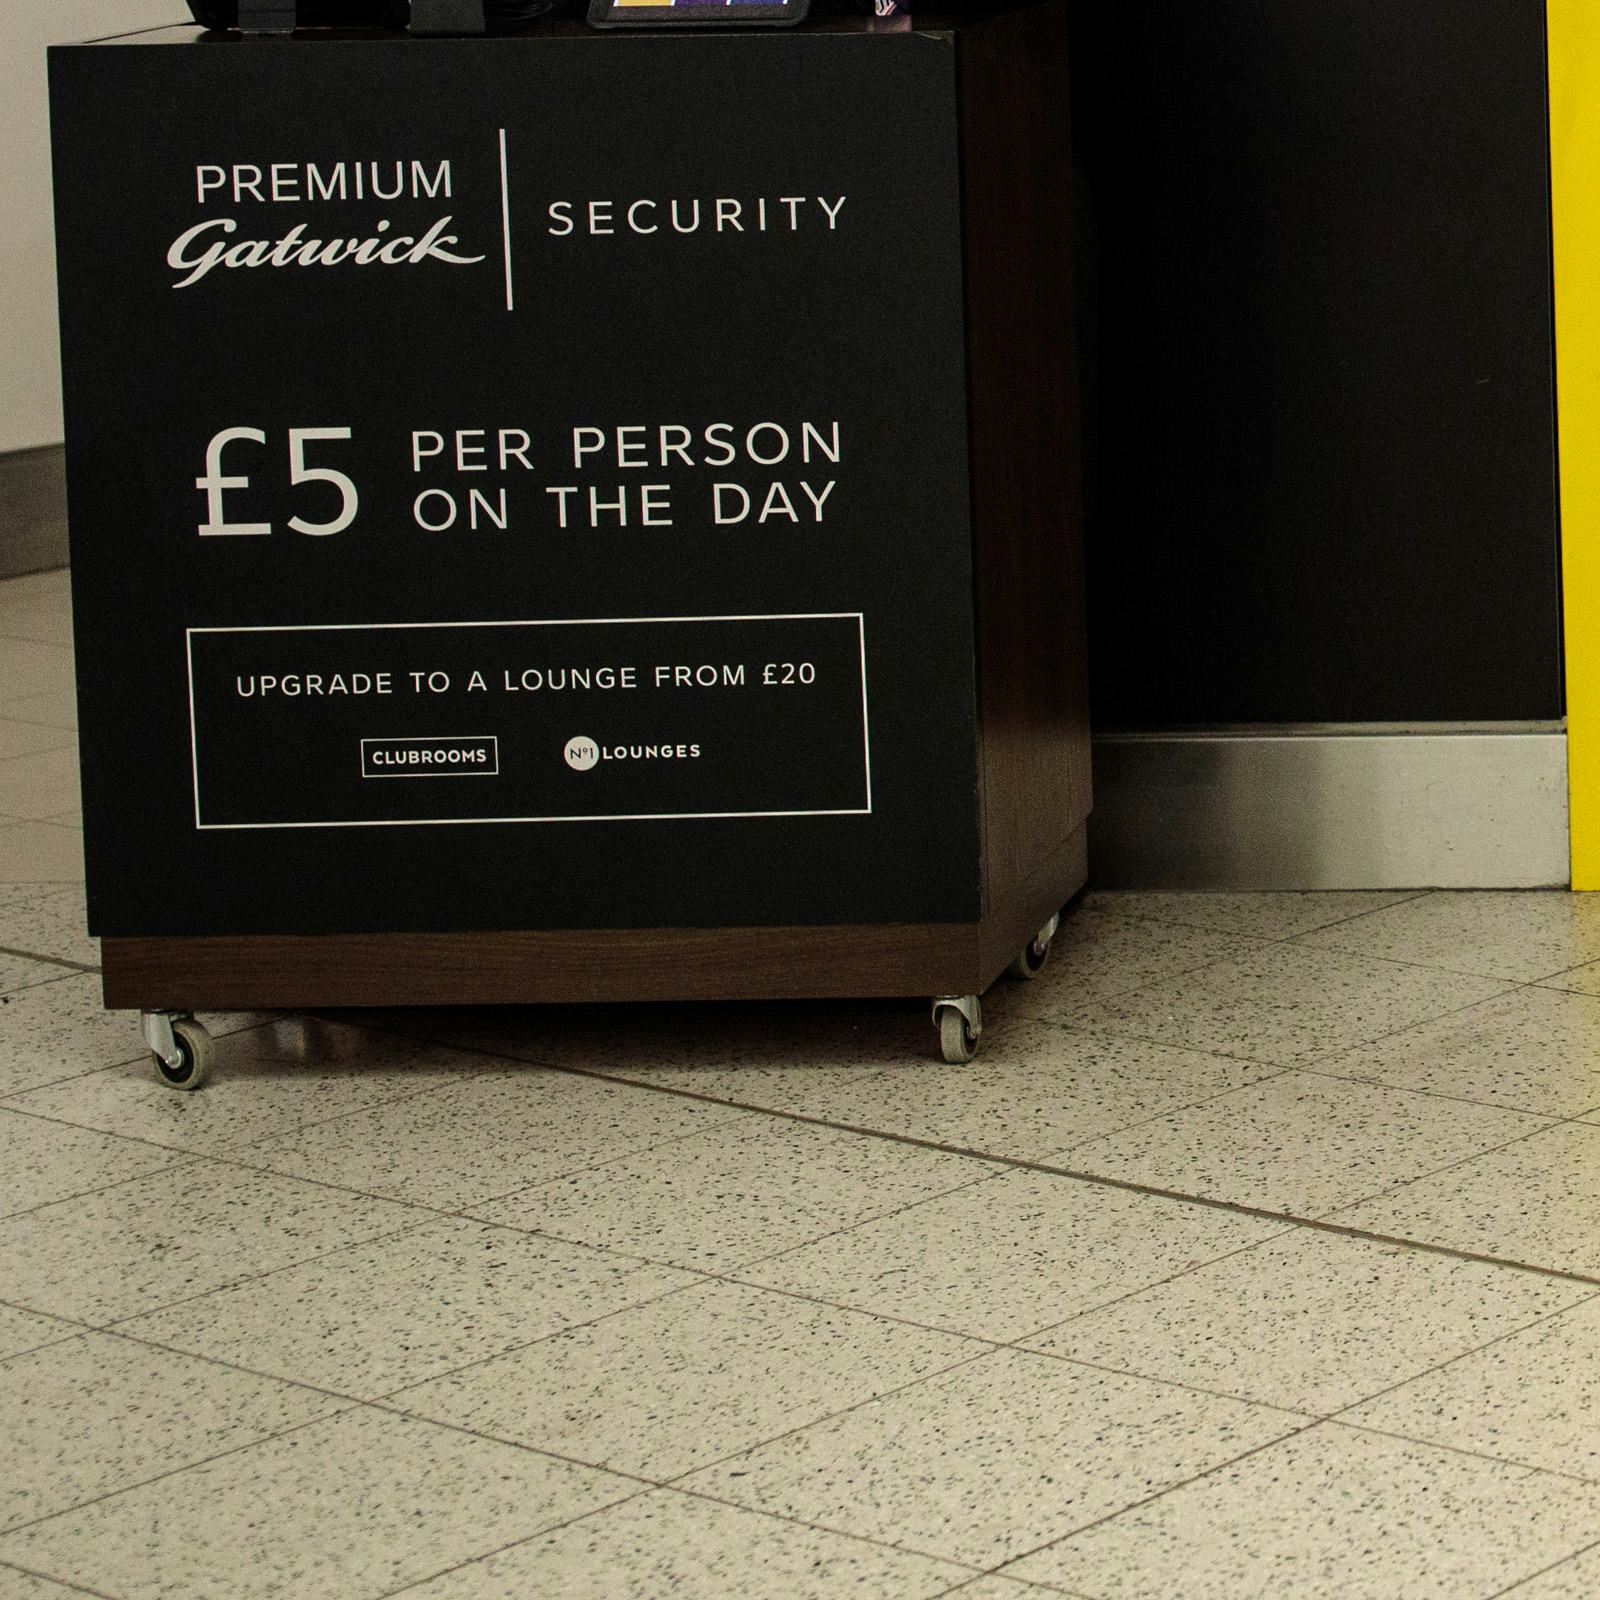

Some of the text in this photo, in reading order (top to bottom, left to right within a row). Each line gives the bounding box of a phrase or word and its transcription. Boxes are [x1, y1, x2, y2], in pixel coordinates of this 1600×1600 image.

[195, 159, 453, 204] PREMIUM
[547, 196, 848, 236] SECURITY
[166, 214, 487, 289] Gatwick
[412, 421, 841, 473] PER PERSON
[195, 426, 360, 537] £5
[413, 480, 837, 532] ON THE DAY
[236, 661, 817, 698] UPGRADE TO A LOUNGE FROM £20
[372, 748, 487, 766] CLUBROOMS
[602, 744, 701, 760] LOUNGES
